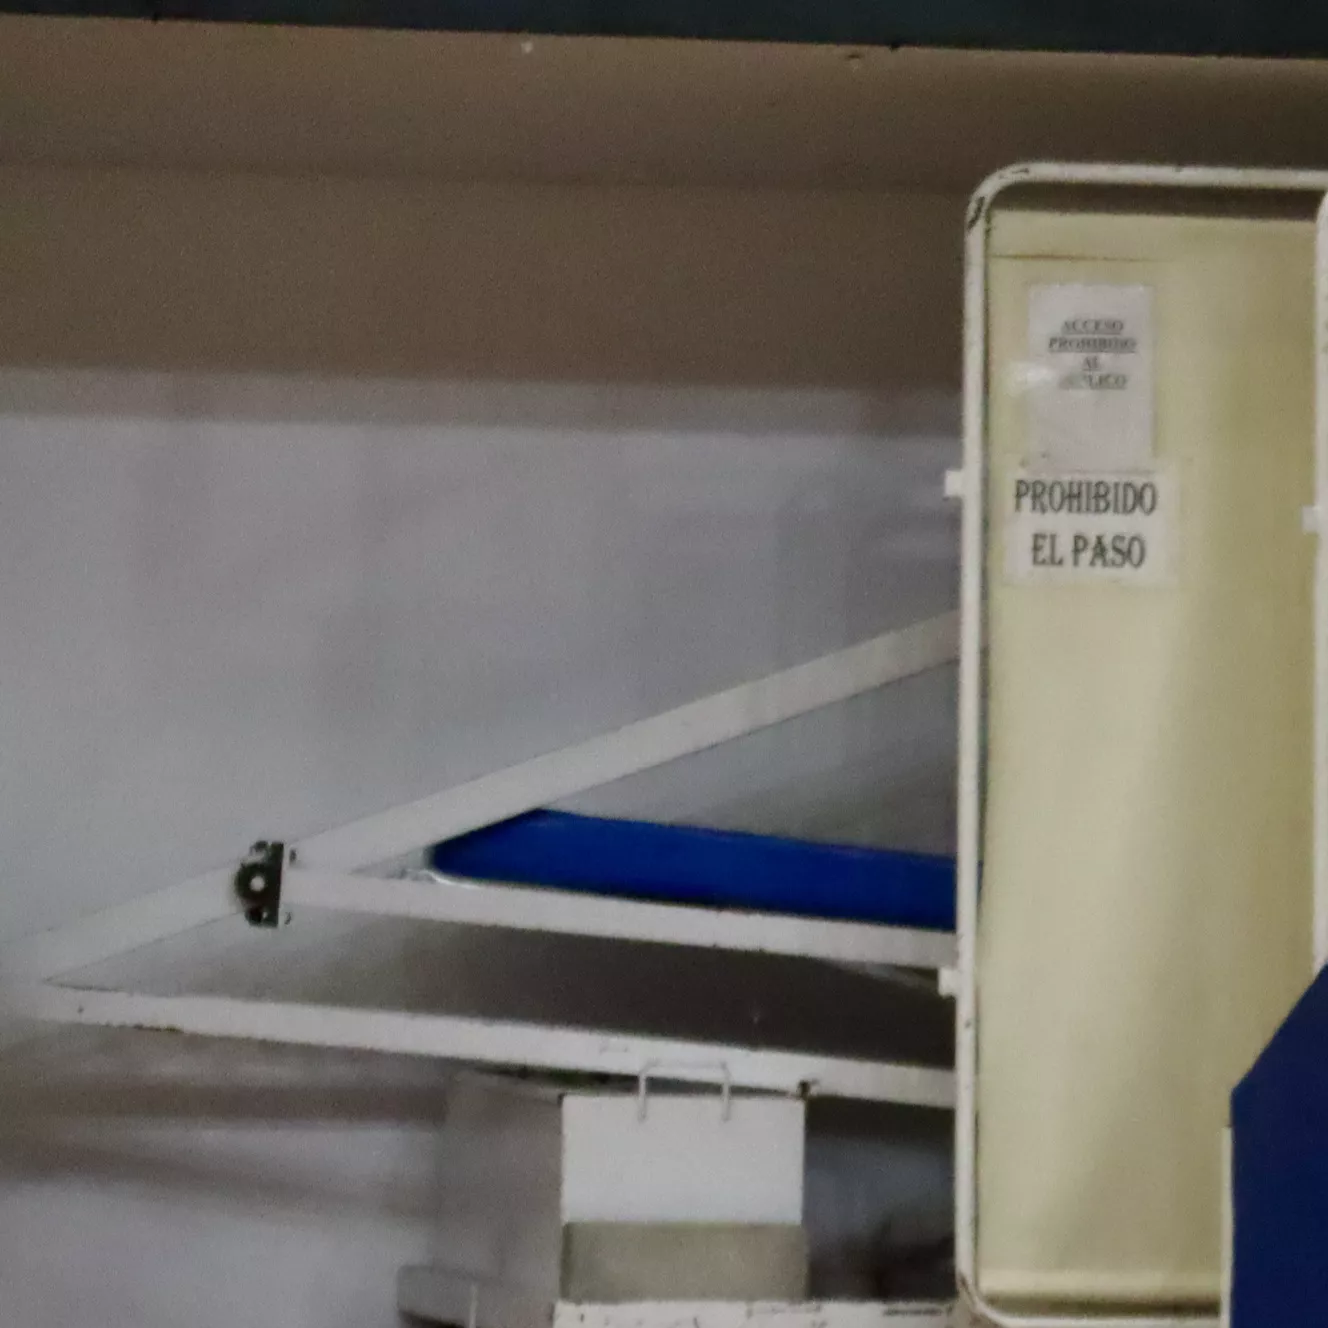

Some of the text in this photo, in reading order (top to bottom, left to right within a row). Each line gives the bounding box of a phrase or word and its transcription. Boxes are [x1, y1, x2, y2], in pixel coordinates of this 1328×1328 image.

[1014, 479, 1158, 516] PROHIBIDO
[1032, 532, 1146, 569] EL PASO
